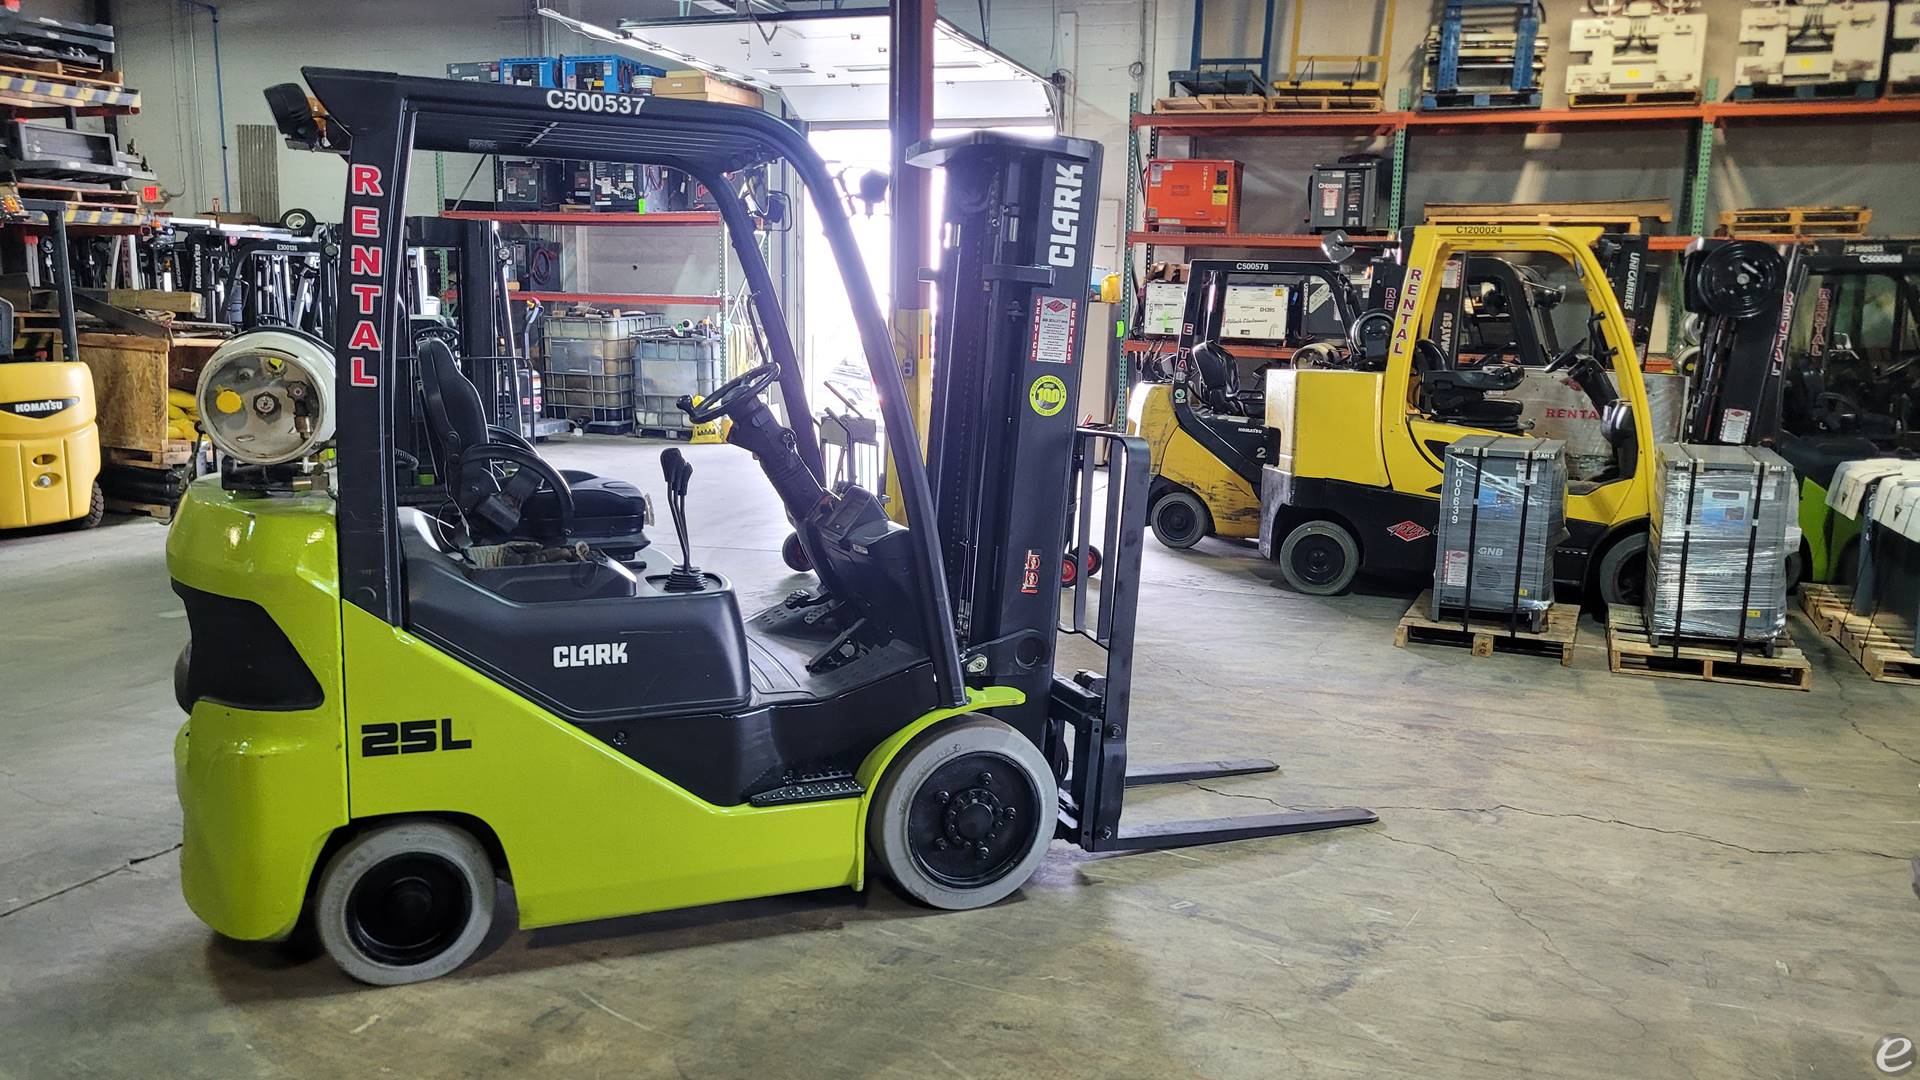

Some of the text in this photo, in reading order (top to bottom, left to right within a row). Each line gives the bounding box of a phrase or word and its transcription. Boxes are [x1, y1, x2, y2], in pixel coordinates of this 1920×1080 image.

[546, 90, 646, 115] C500537
[1048, 163, 1084, 267] CLARK
[1456, 226, 1503, 234] C1200024
[193, 244, 202, 289] KOMATSU
[348, 163, 384, 387] RENTAL
[1236, 262, 1269, 271] C500578
[1624, 252, 1640, 311] UNICARRIERS
[1032, 298, 1041, 358] SERVICE
[1066, 302, 1077, 360] RENTALS
[1393, 269, 1422, 354] RENTAL
[1811, 288, 1831, 356] RENTAL
[15, 400, 63, 412] KOMATSU
[1037, 388, 1060, 404] 100
[1451, 459, 1464, 524] CH00639
[1478, 546, 1504, 557] GNB
[553, 642, 628, 668] CLARK
[361, 718, 472, 757] 25L
